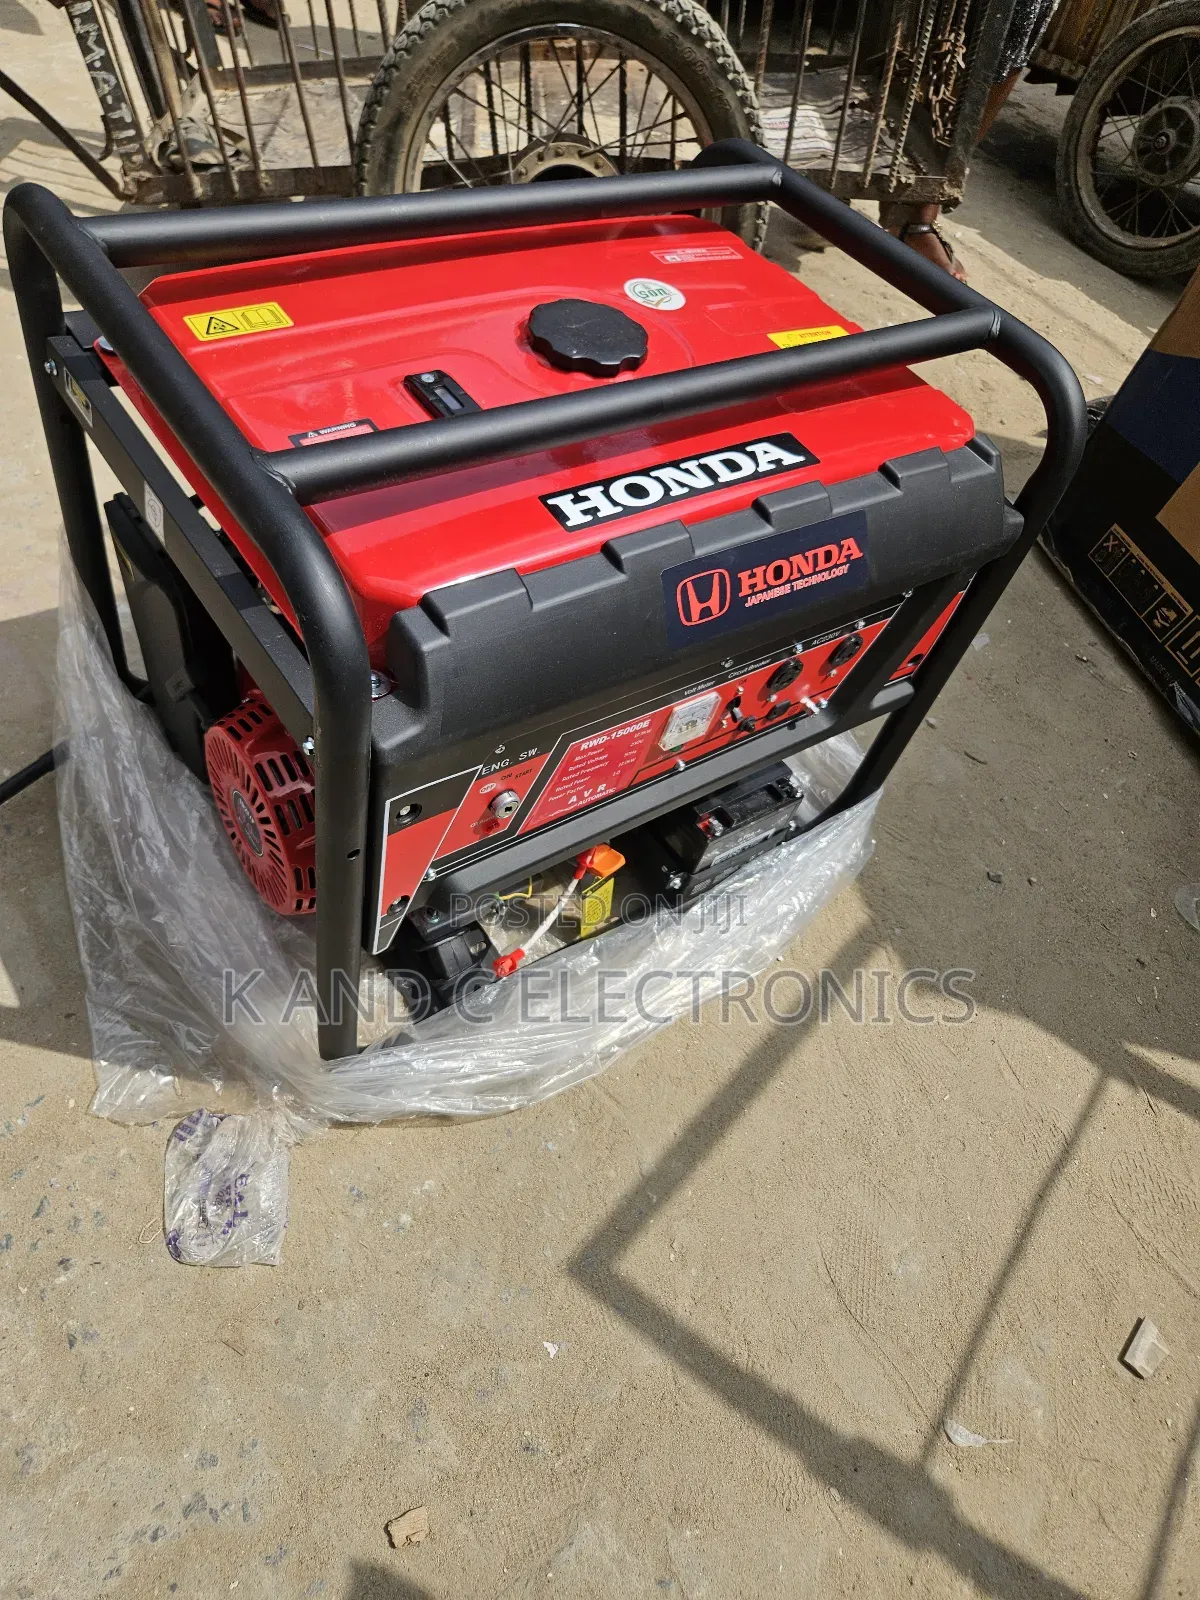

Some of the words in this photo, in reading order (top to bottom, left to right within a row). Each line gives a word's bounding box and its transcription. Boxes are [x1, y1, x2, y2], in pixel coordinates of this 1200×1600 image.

[319, 422, 357, 435] WARNING
[546, 441, 806, 527] HONDA
[737, 537, 864, 598] HONDA
[745, 583, 792, 608] JAPANESE
[793, 564, 850, 592] TECHNOLOGY
[580, 719, 652, 751] RWD-15000E
[481, 759, 513, 776] ENG.
[518, 747, 541, 761] SW.
[501, 773, 513, 781] ON
[515, 769, 533, 779] START
[577, 787, 617, 806] AUTOMATIC
